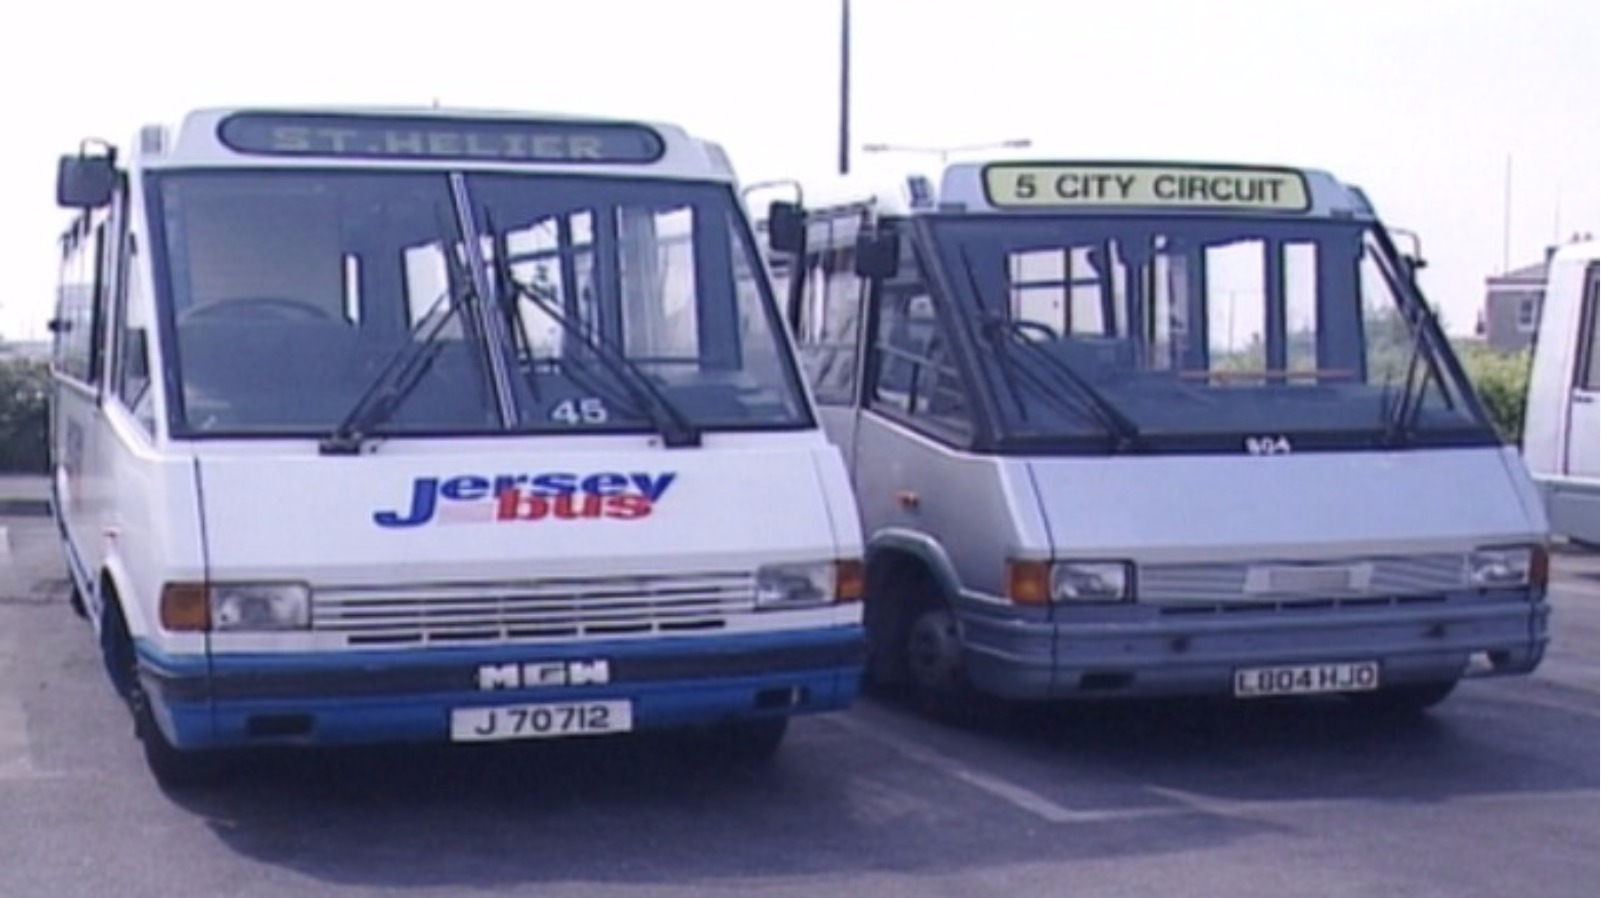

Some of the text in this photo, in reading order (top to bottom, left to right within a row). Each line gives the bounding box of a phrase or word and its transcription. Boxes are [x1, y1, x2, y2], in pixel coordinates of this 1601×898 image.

[1014, 174, 1286, 202] 5 CITY CIRCUIT
[551, 398, 608, 426] 45
[372, 471, 678, 528] Jersey
[496, 489, 653, 522] bus
[475, 705, 610, 735] J 70712
